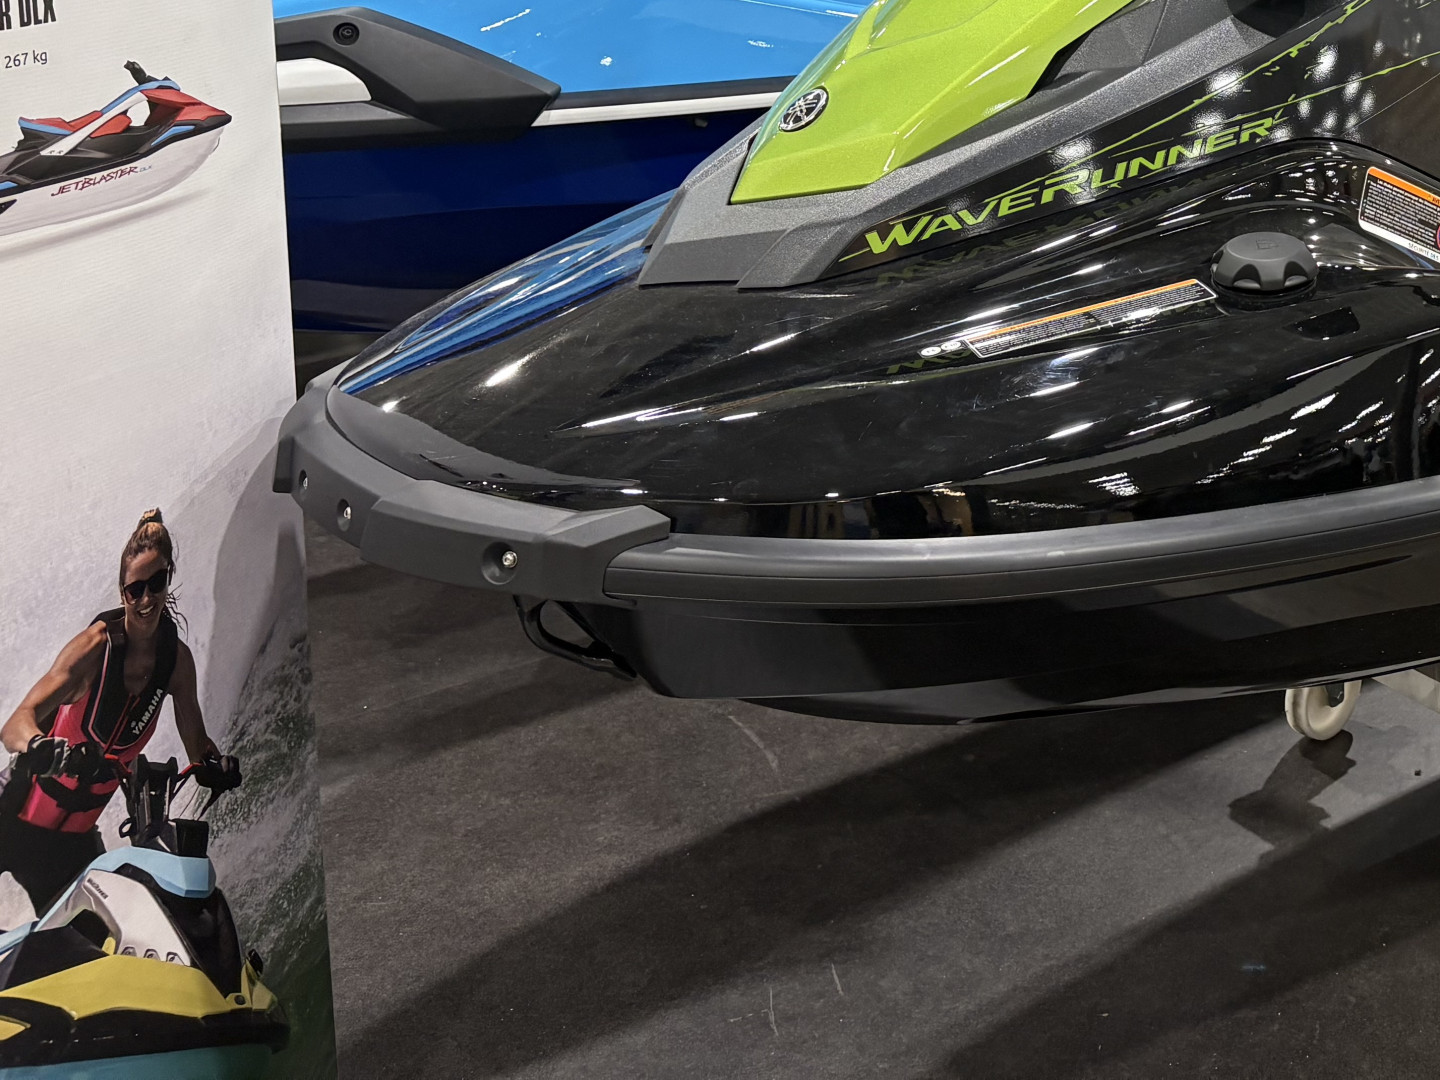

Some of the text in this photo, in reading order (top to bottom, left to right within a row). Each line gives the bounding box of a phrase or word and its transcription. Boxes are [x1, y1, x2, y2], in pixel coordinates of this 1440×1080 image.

[4, 49, 48, 69] 267 kg
[51, 166, 139, 197] JETBLASTER
[132, 687, 163, 736] YAMAHA
